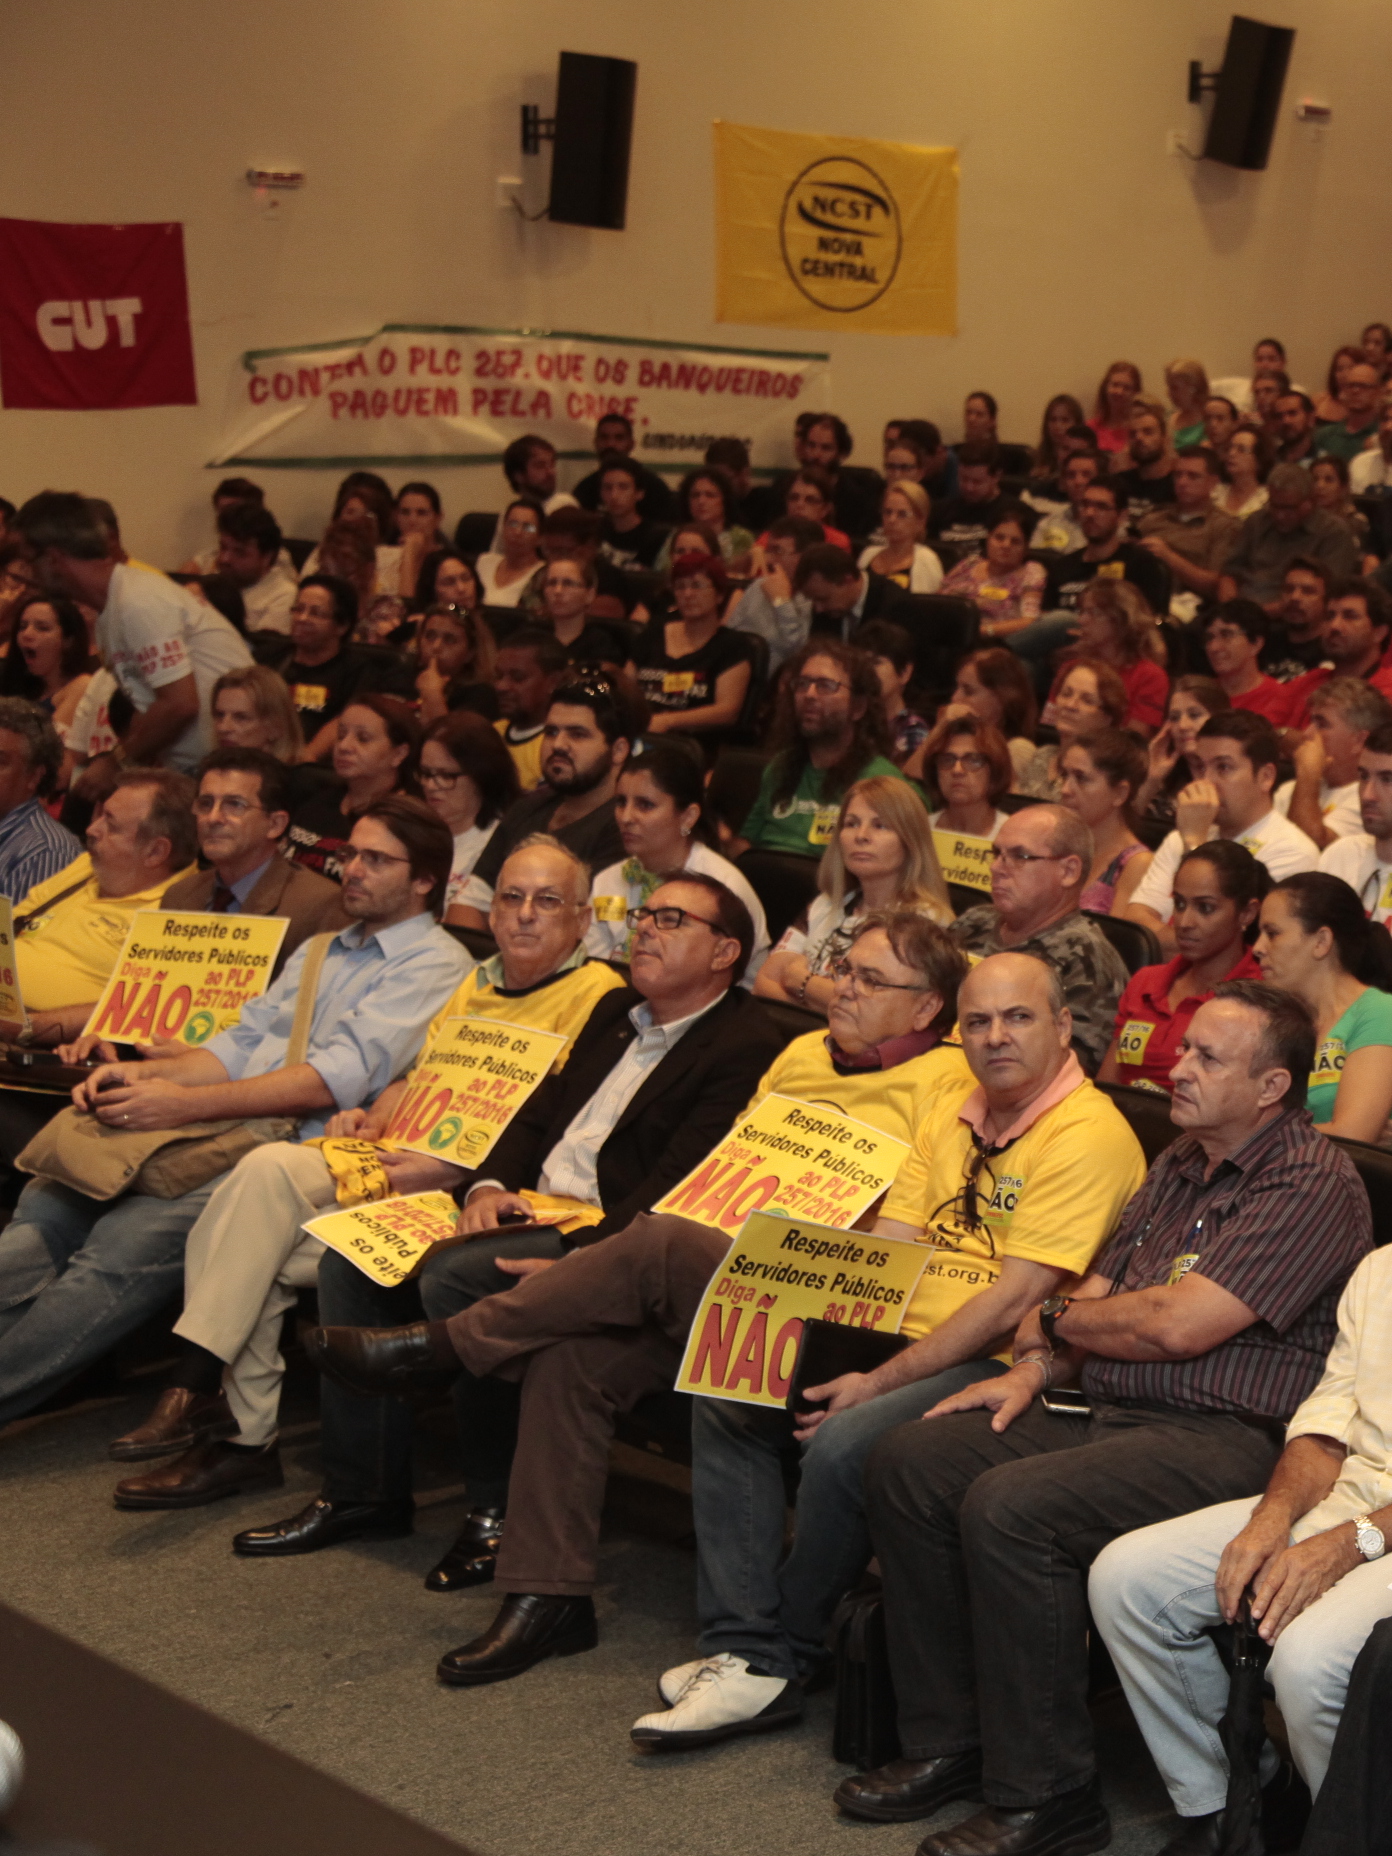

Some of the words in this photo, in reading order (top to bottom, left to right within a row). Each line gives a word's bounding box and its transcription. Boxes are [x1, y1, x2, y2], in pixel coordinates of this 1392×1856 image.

[812, 195, 876, 222] NCST
[817, 235, 865, 258] NOVA
[800, 257, 881, 284] CENTRAL
[36, 297, 143, 353] CUT
[378, 346, 398, 377] O
[407, 346, 462, 377] PLC
[535, 353, 586, 383] QUE
[638, 358, 804, 401] BANQUEIROS
[327, 386, 460, 421] PAGUEM
[472, 386, 553, 419] PELA
[162, 918, 229, 942] Respeite
[232, 926, 251, 941] os
[127, 943, 203, 964] Servidores
[207, 946, 270, 968] Públicos
[120, 961, 151, 982] Diga
[204, 971, 224, 986] ao
[225, 967, 256, 988] PLP
[93, 970, 193, 1040] NÃO
[455, 1024, 511, 1049] Respeite
[510, 1038, 531, 1054] os
[1119, 1032, 1142, 1052] ÃO
[478, 1055, 538, 1085] Públicos
[467, 1077, 489, 1095] ao
[487, 1077, 520, 1101] PLP
[447, 1092, 514, 1126] 257/2016
[782, 1107, 854, 1145] Respeite
[853, 1135, 878, 1155] os
[719, 1140, 751, 1163] Diga
[797, 1170, 818, 1189] ao
[820, 1175, 861, 1203] PLP
[736, 1124, 815, 1160] Servidores
[812, 1147, 884, 1190] Públicos
[665, 1154, 781, 1230] NÃO
[772, 1184, 853, 1228] 257/2016
[780, 1228, 865, 1265] Respeite
[865, 1249, 890, 1269] os
[728, 1253, 828, 1291] Servidores
[829, 1272, 905, 1306] Públicos
[714, 1276, 757, 1306] Diga
[822, 1301, 847, 1324] ao
[849, 1301, 887, 1331] PLP
[688, 1292, 805, 1400] NÃO
